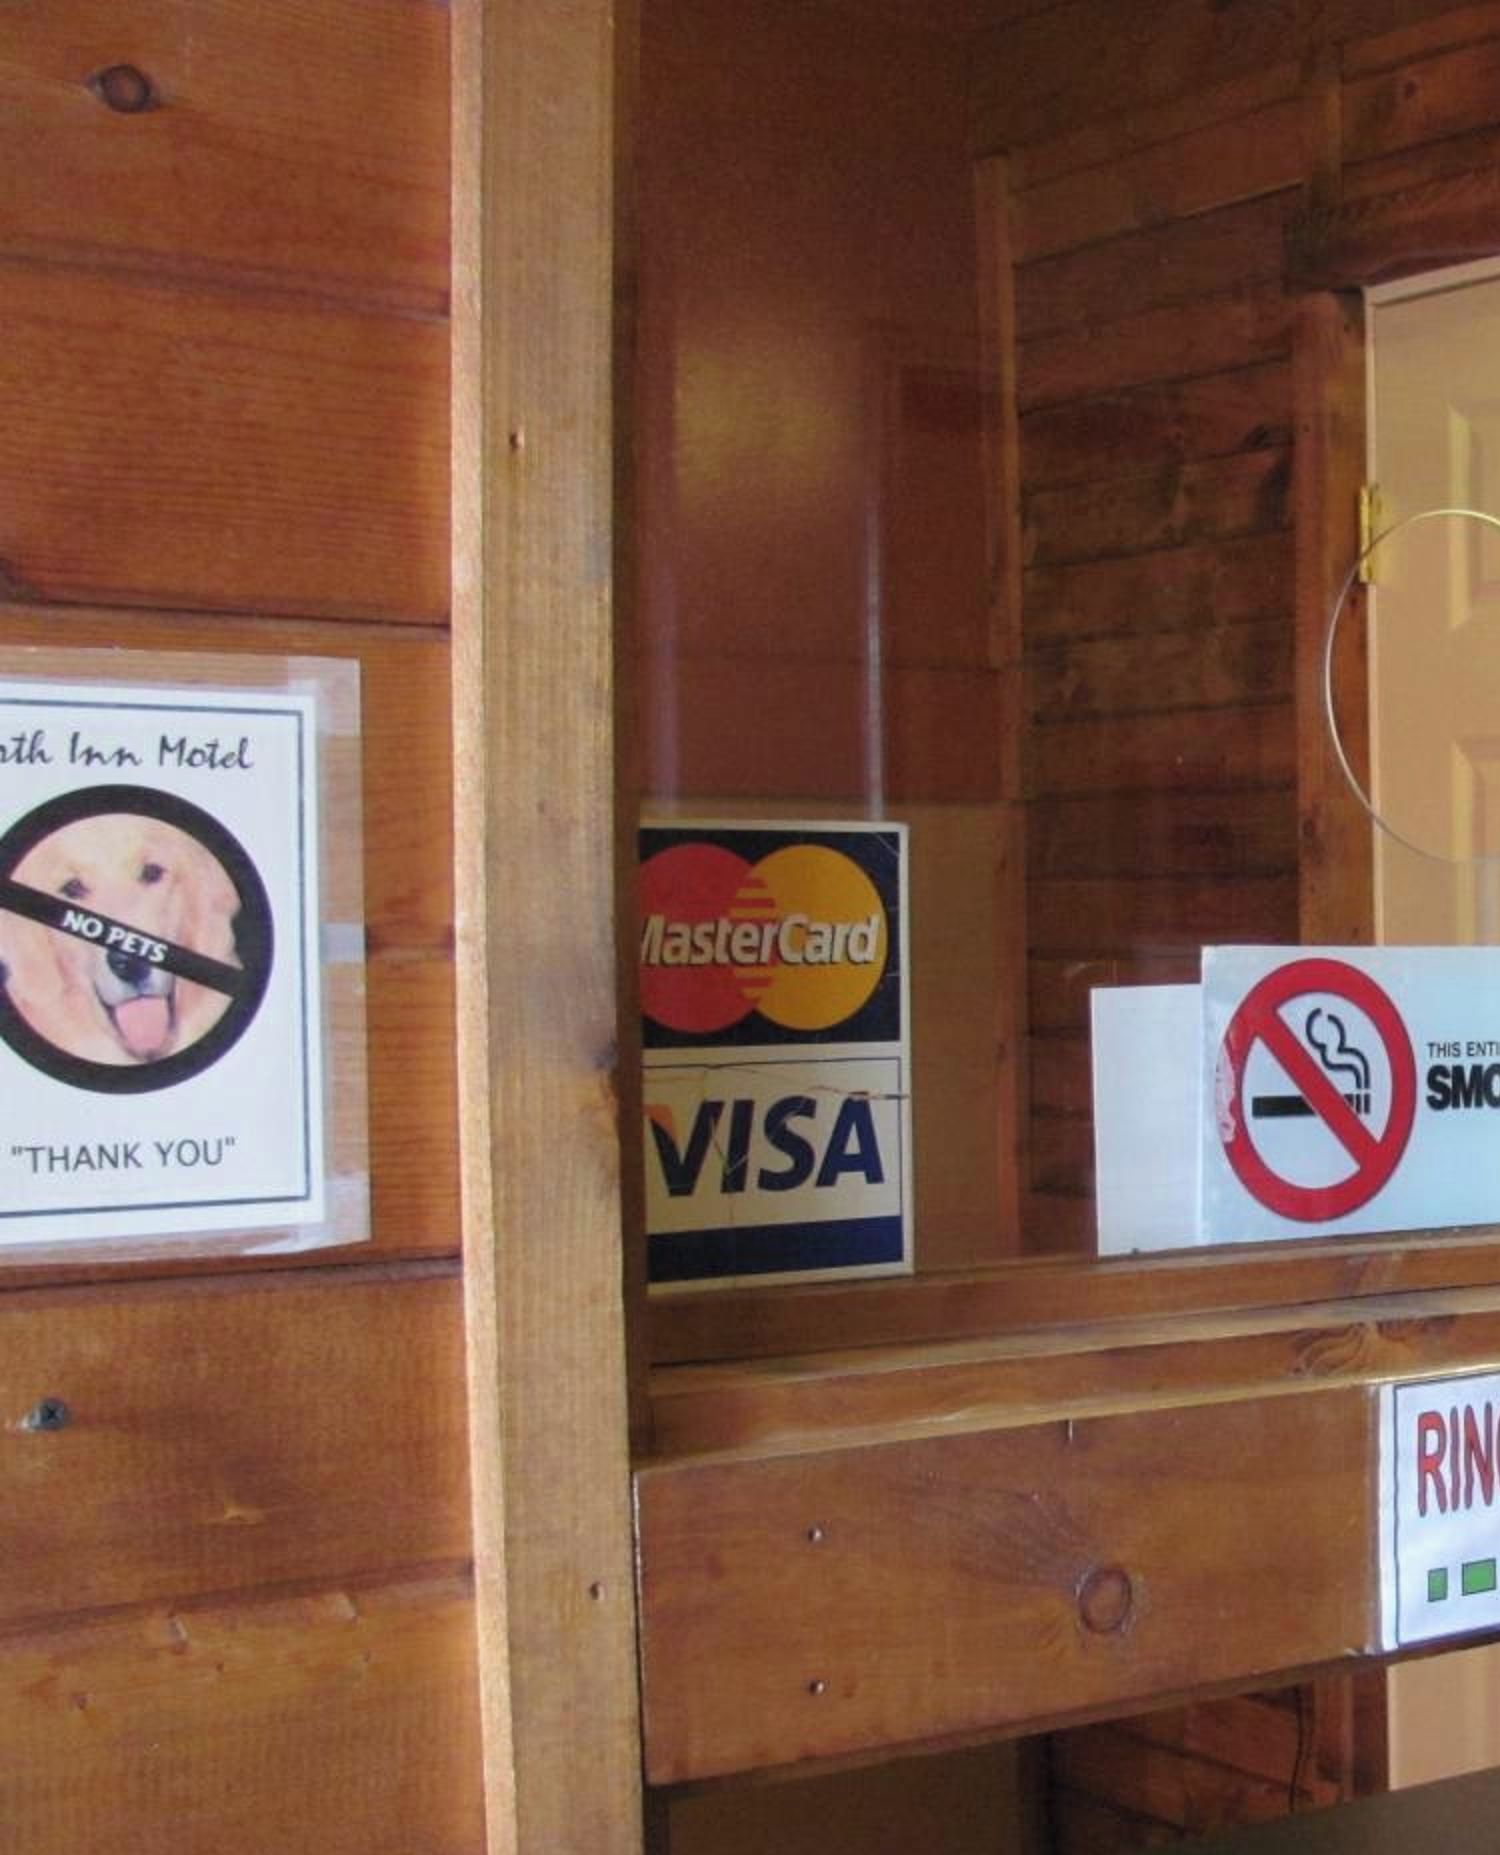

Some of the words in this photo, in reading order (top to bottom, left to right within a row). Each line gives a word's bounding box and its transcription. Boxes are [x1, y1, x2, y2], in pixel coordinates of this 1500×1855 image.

[69, 732, 143, 767] Inn
[158, 736, 255, 770] Motel
[62, 909, 105, 940] NO
[105, 919, 170, 963] PETS
[1427, 1041, 1462, 1058] THIS
[11, 1143, 142, 1174] "THANK
[154, 1137, 236, 1168] YOU"
[648, 1095, 885, 1197] VISA
